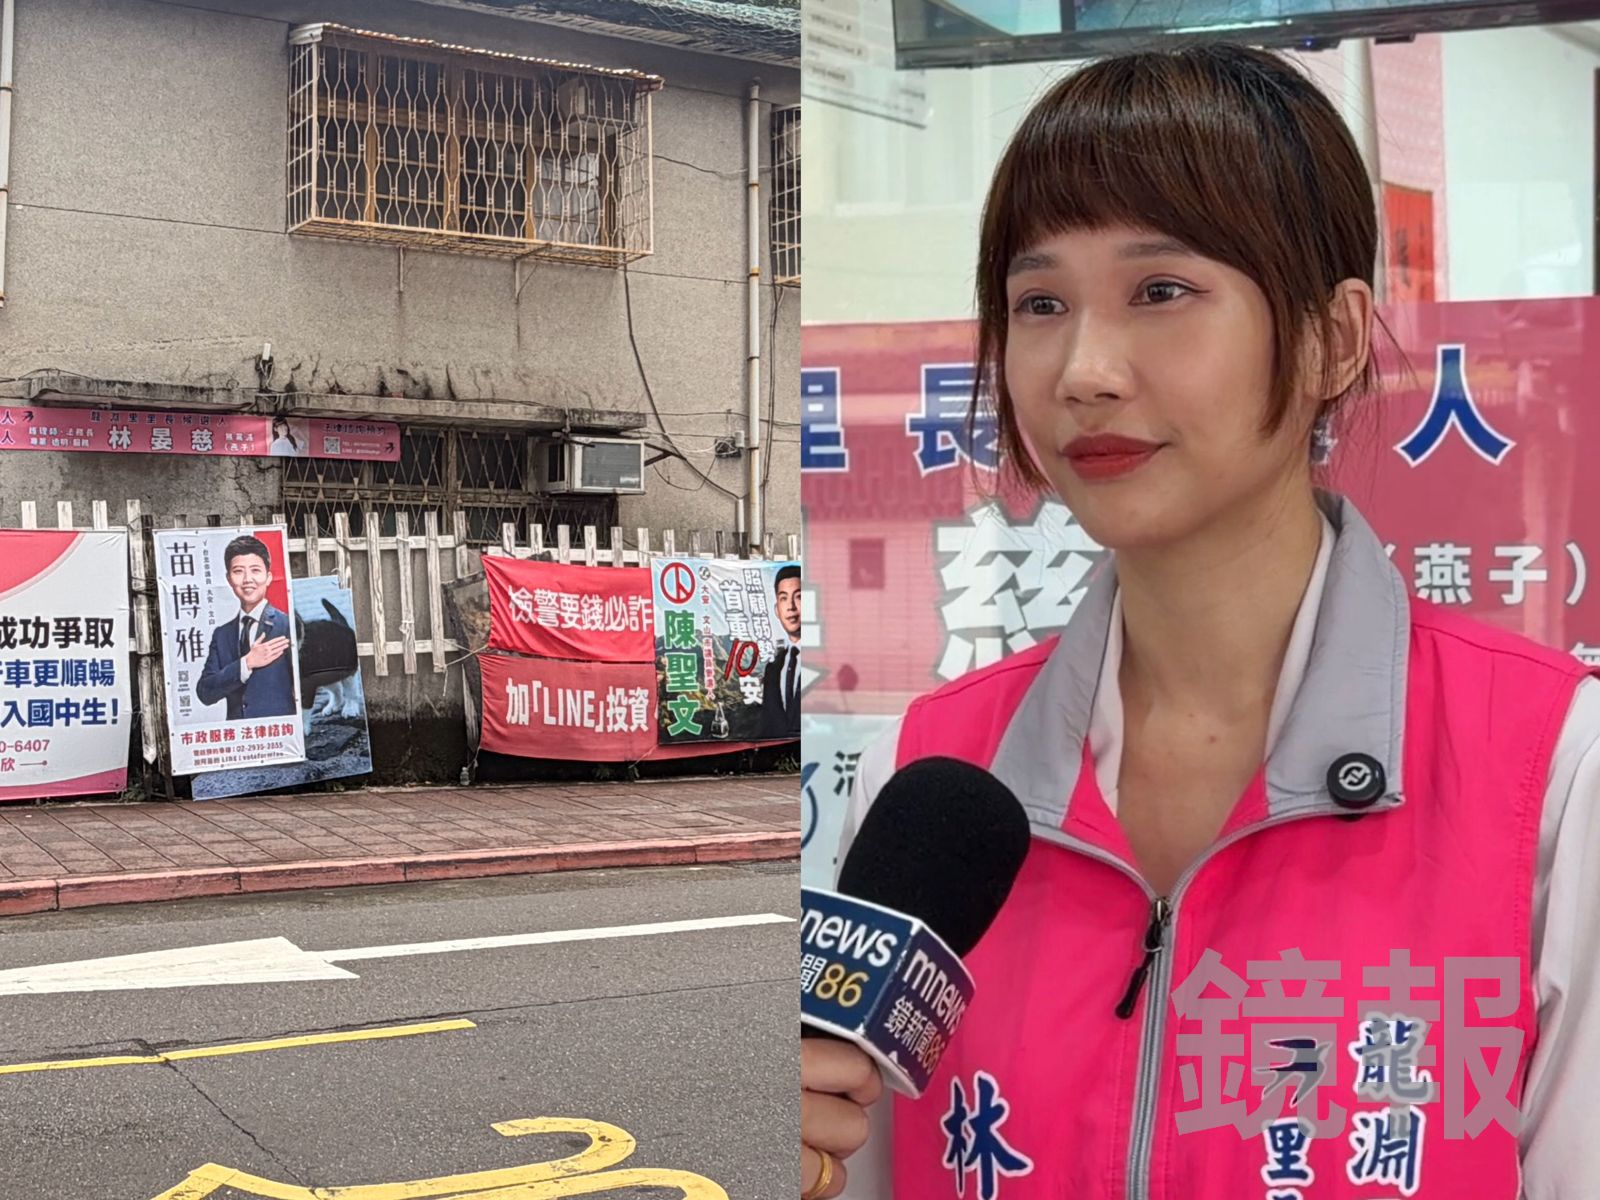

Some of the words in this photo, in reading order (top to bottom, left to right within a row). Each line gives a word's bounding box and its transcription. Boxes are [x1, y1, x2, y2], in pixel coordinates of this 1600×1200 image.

[1395, 344, 1513, 467] 人
[166, 541, 205, 663] 苗博雅
[1385, 542, 1587, 605] 燕子)
[0, 658, 116, 688] 車更順暢
[664, 609, 703, 737] 陳聖文
[181, 728, 236, 745] 市政服務
[800, 908, 898, 968] news
[903, 949, 966, 1036] mnews
[940, 1069, 1035, 1200] 林
[1348, 1012, 1437, 1196] 龍淵
